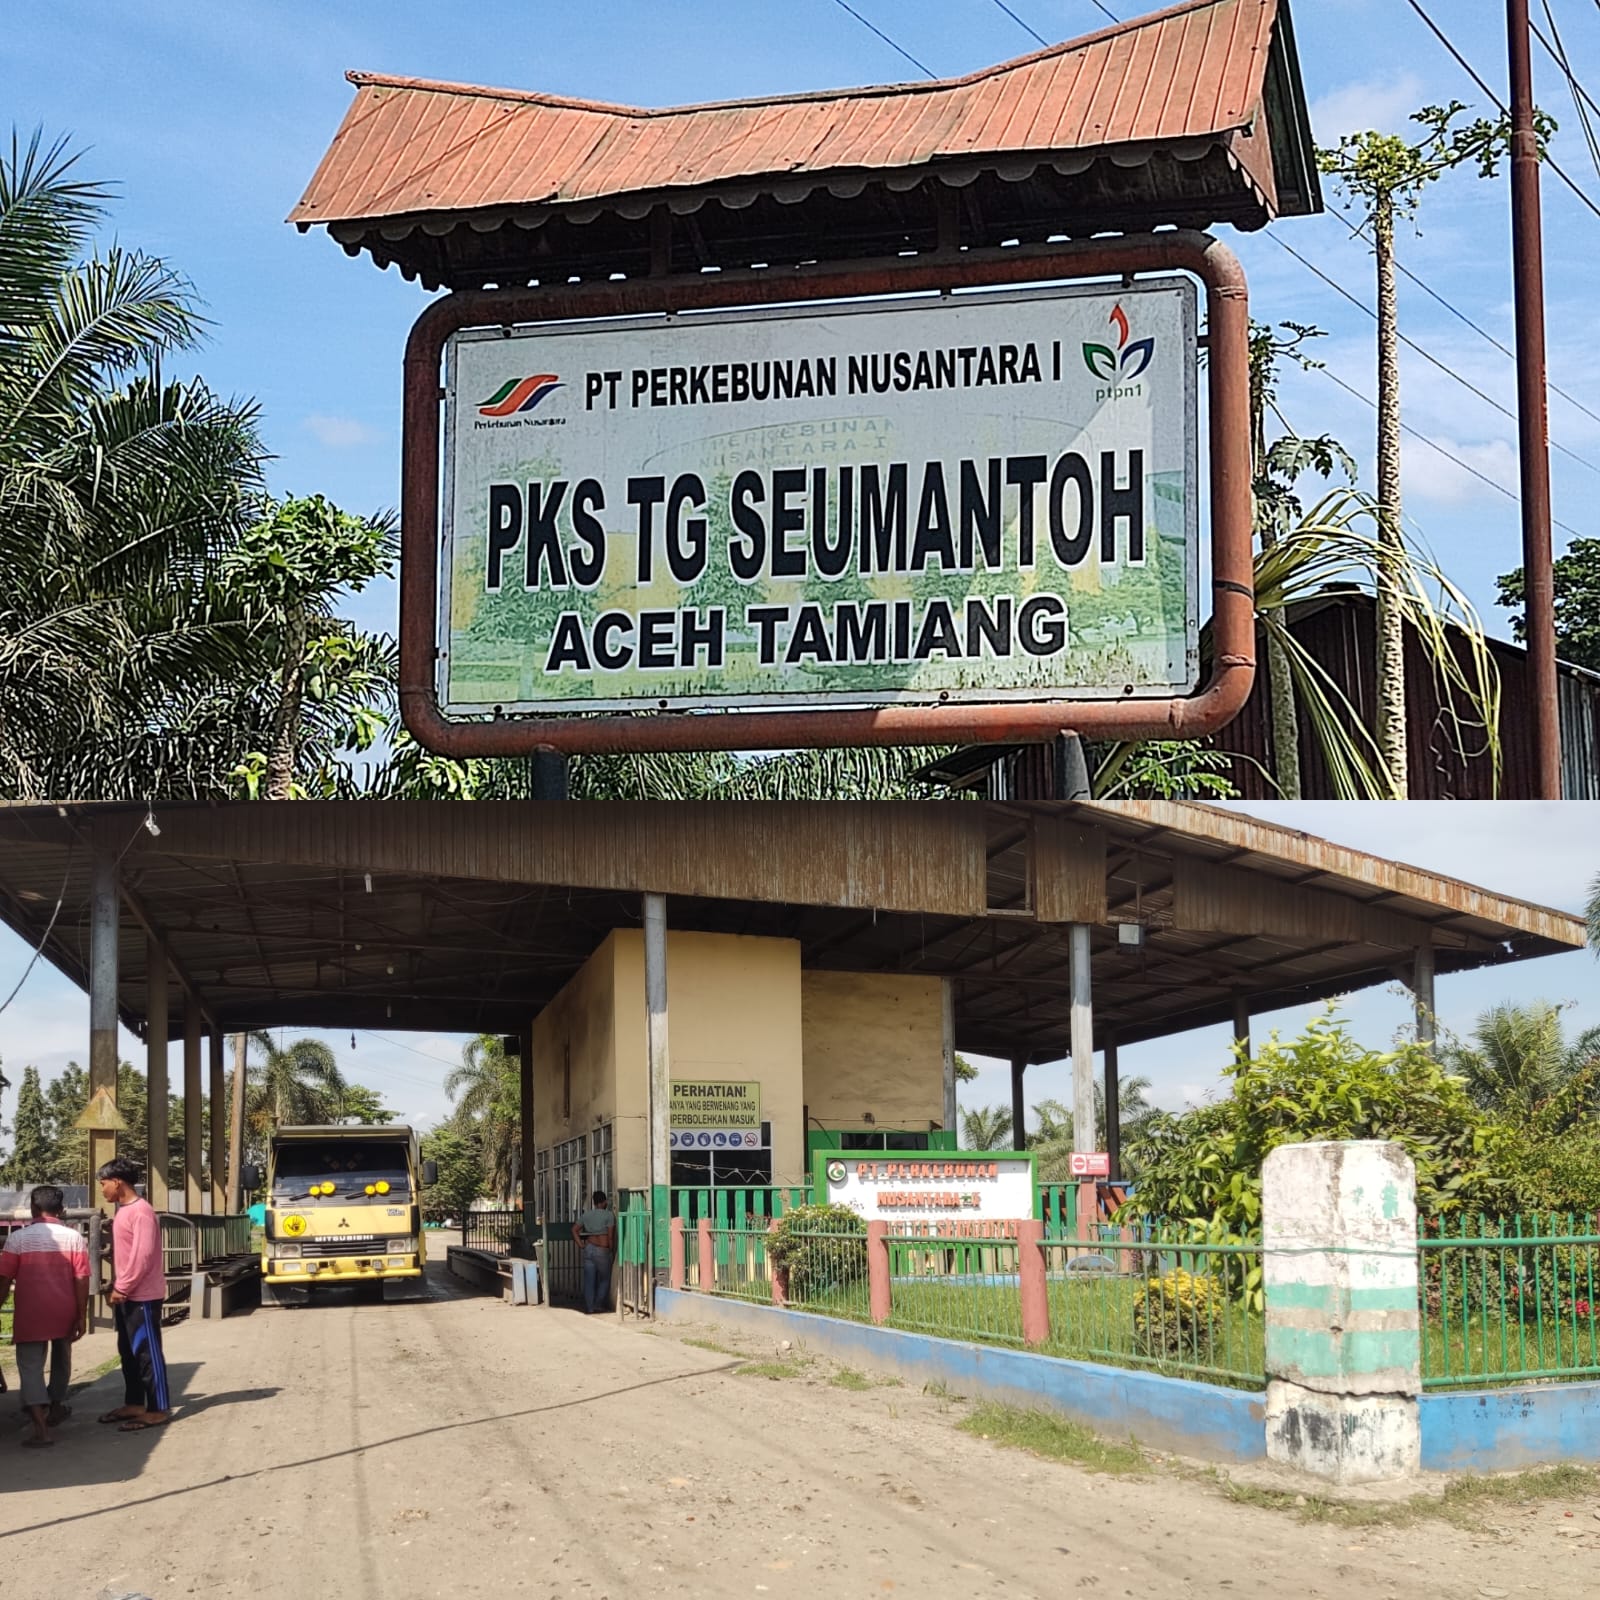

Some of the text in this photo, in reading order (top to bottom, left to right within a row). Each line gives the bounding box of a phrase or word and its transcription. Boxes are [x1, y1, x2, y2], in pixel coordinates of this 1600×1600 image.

[586, 341, 1061, 410] PT PERKEBUNAN NUSANTARA I
[1095, 384, 1142, 402] ptpn1
[474, 419, 523, 430] Perkebunan
[486, 449, 1144, 589] PKS TG SEUMANTOH
[545, 596, 1066, 671] ACEH TAMIANG
[673, 1084, 746, 1097] PERHATIAN!
[669, 1101, 756, 1111] ANYA YANG BERWENANG YANG
[670, 1114, 756, 1124] IPERBOLEHKAN MASUK
